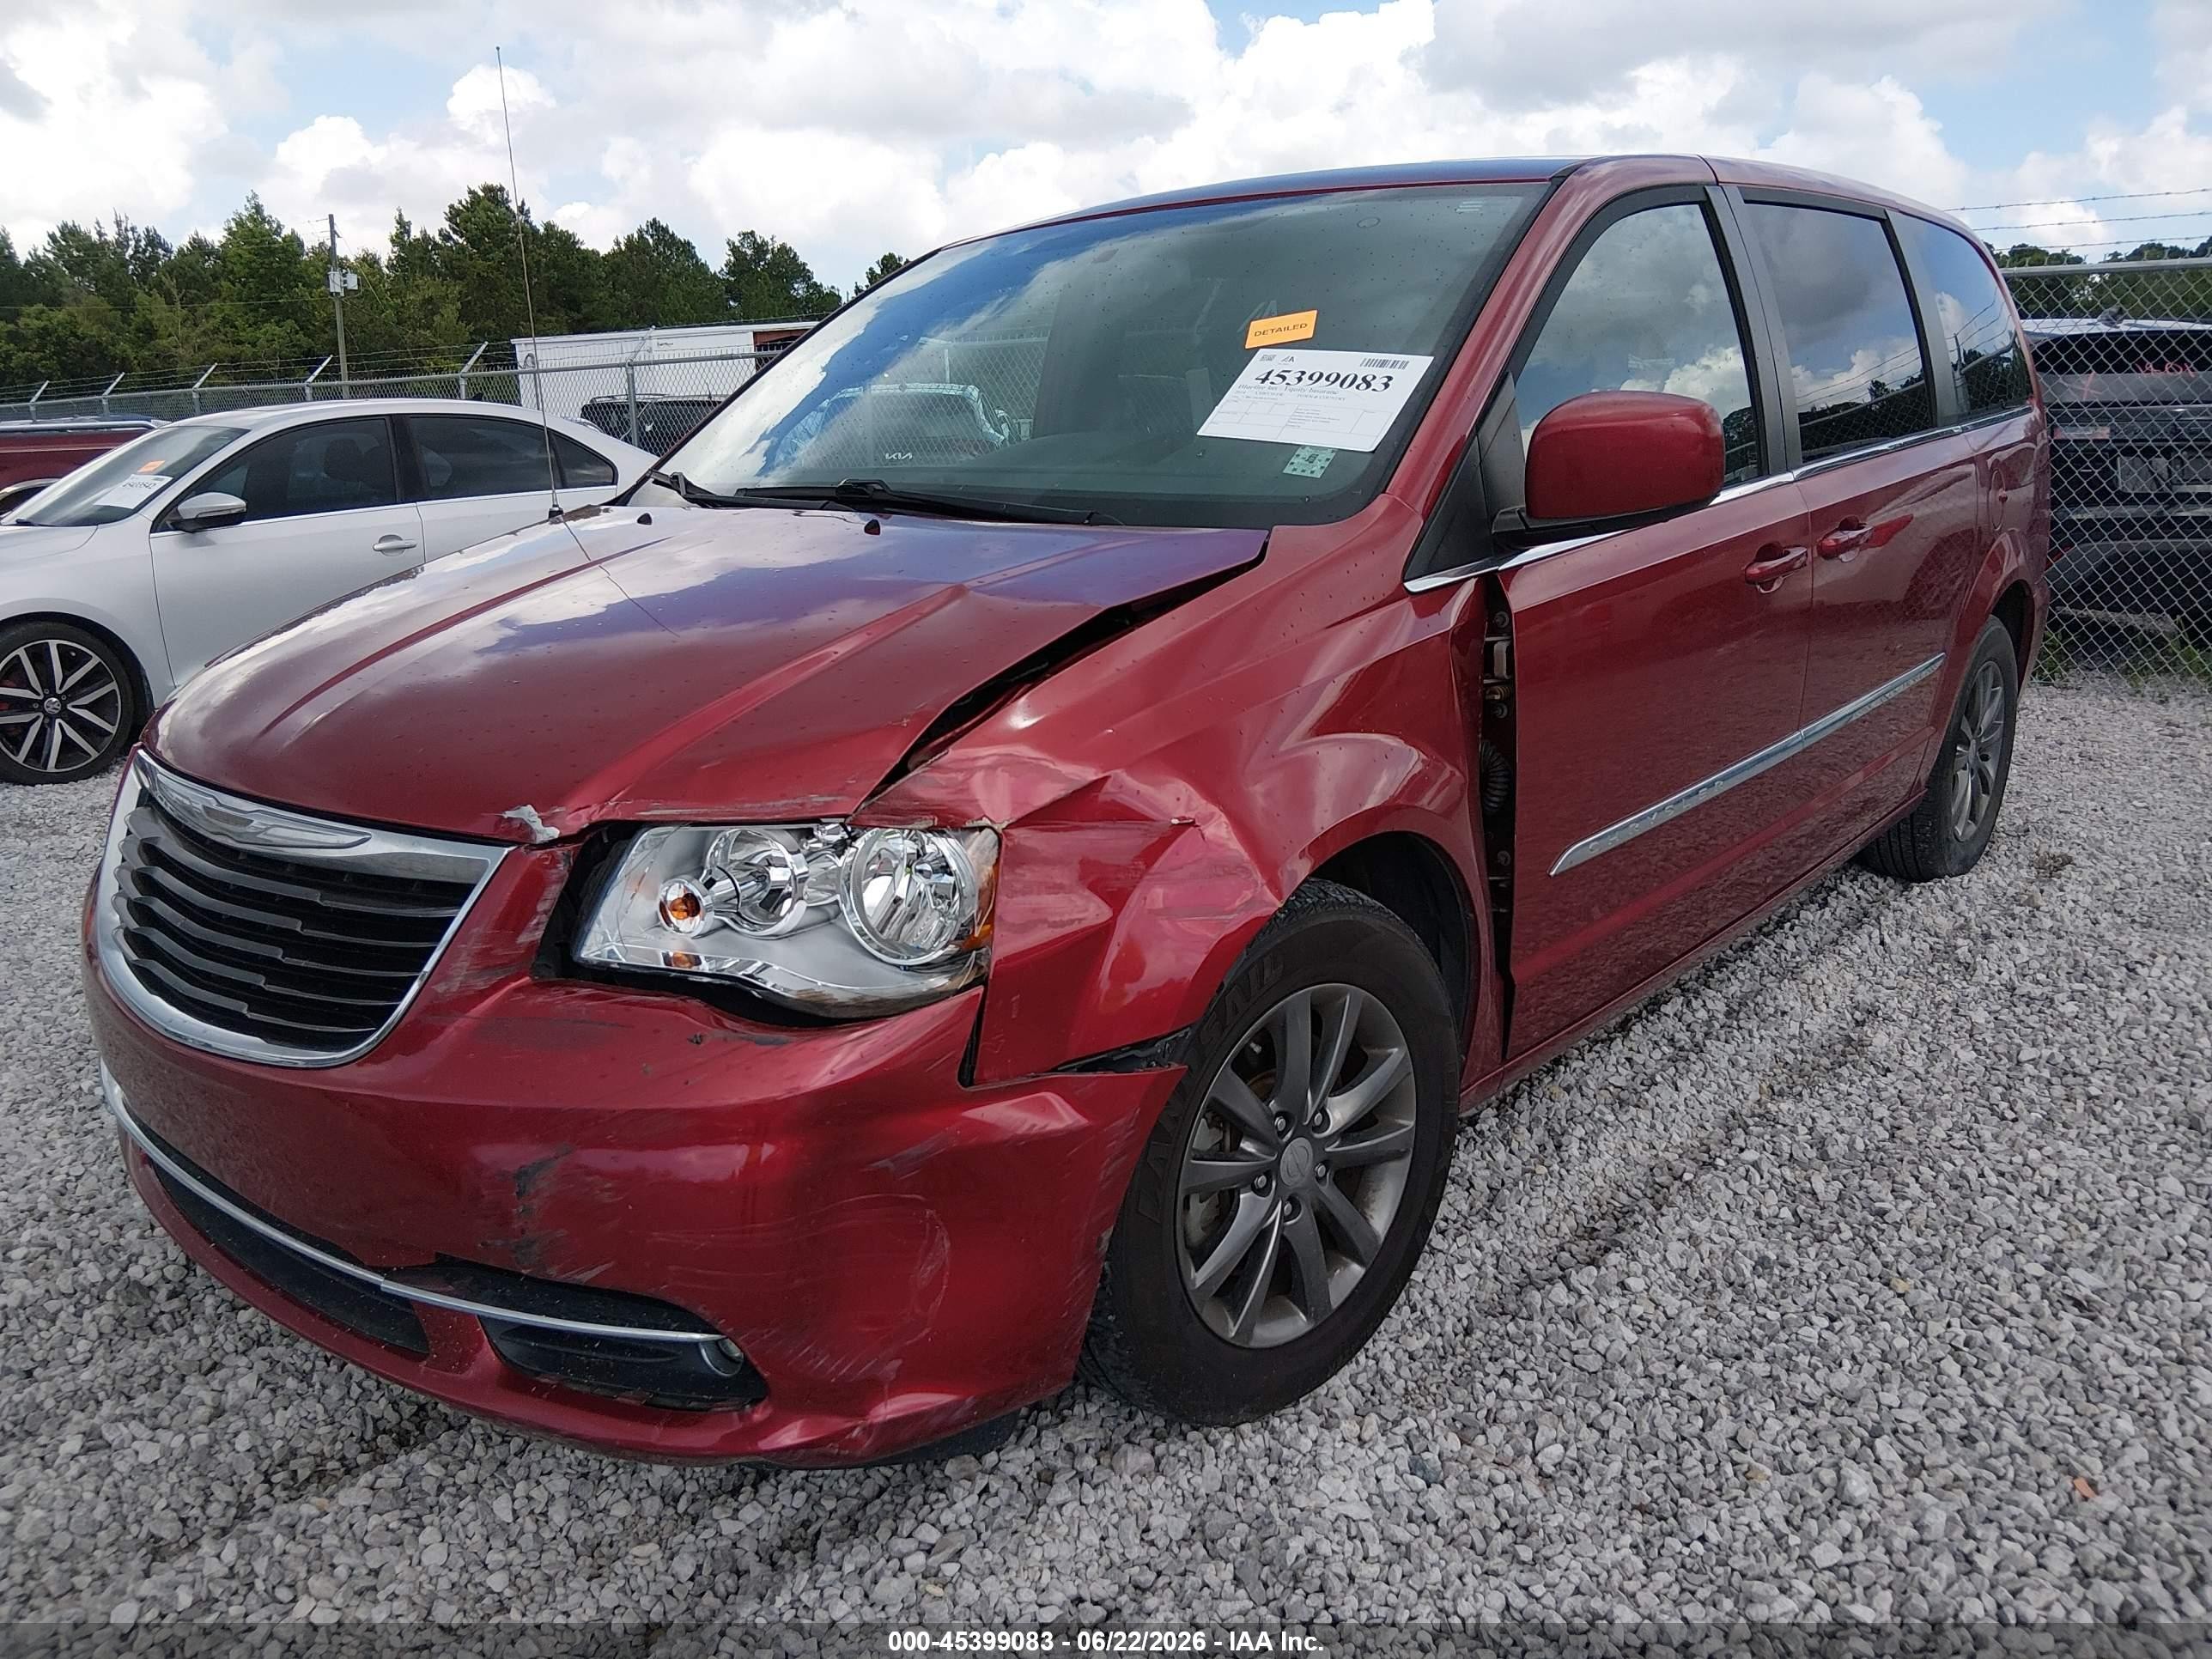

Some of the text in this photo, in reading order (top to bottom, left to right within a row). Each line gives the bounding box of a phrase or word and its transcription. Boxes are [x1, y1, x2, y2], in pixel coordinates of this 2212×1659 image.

[1255, 323, 1308, 337] DETAILED
[1255, 368, 1394, 392] 45399083
[1589, 781, 1724, 853] CHRYSLER
